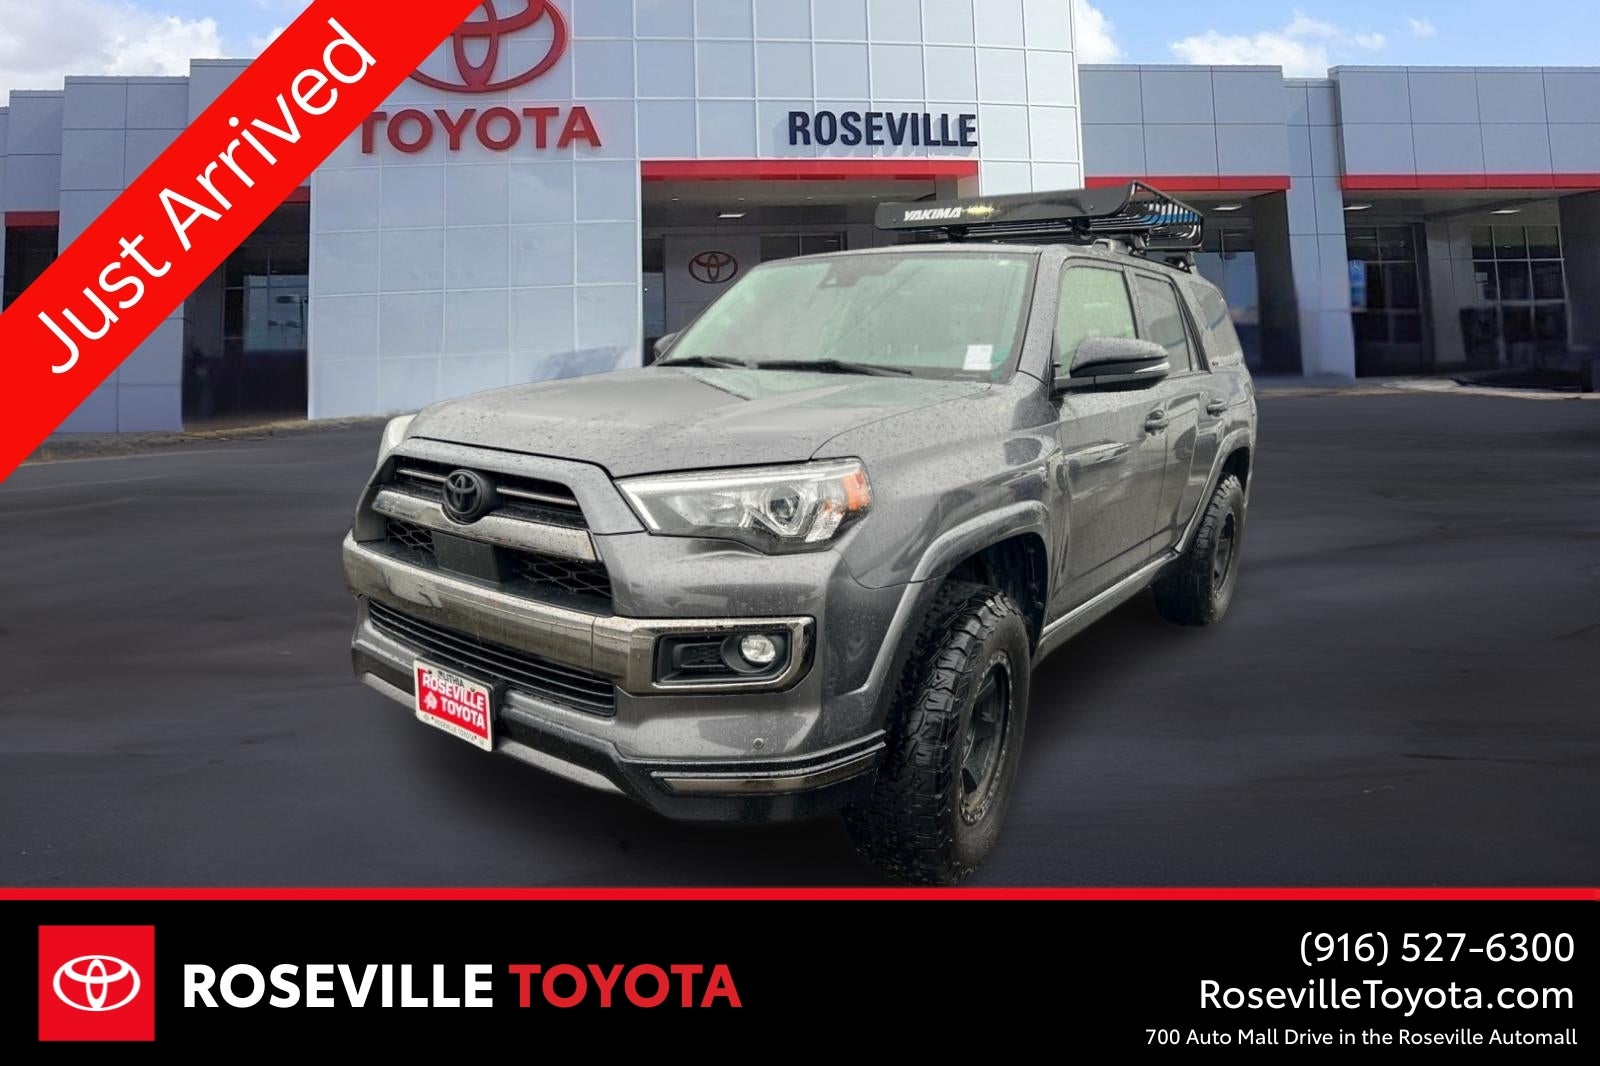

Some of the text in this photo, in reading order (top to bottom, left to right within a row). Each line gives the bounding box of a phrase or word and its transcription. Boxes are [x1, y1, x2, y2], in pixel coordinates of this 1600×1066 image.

[361, 106, 602, 154] TOYOTA
[788, 111, 978, 147] ROSEVILLE
[903, 206, 962, 222] YAKIMA
[422, 672, 485, 712] ROSEVILLE
[440, 696, 486, 730] TOYOTA
